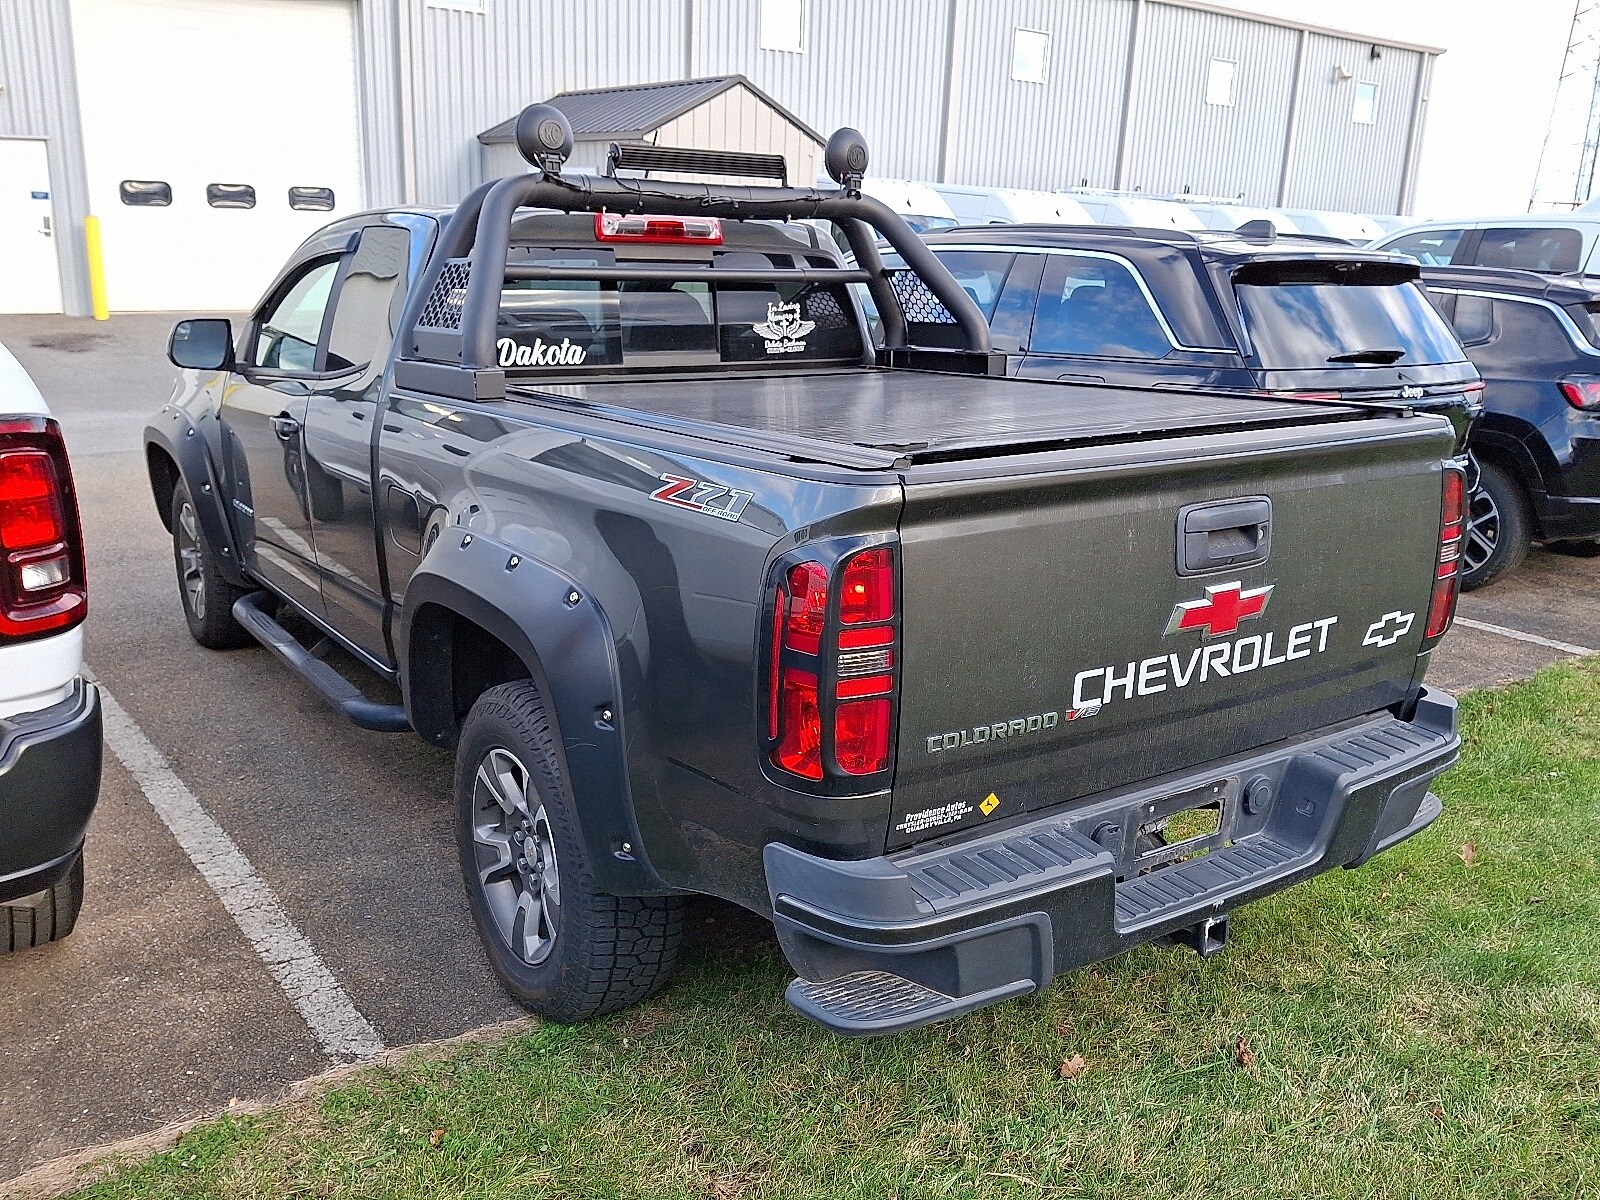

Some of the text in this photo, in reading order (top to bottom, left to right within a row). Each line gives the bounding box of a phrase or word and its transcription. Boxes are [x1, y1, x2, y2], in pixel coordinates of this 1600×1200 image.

[497, 338, 586, 366] Dakota
[1402, 386, 1423, 399] Jeep
[649, 473, 754, 520] Z71
[702, 506, 738, 520] OFF ROAD
[1072, 616, 1338, 709] CHEVROLET
[927, 705, 1101, 753] COLORADO V6
[905, 801, 966, 822] Providence Autos
